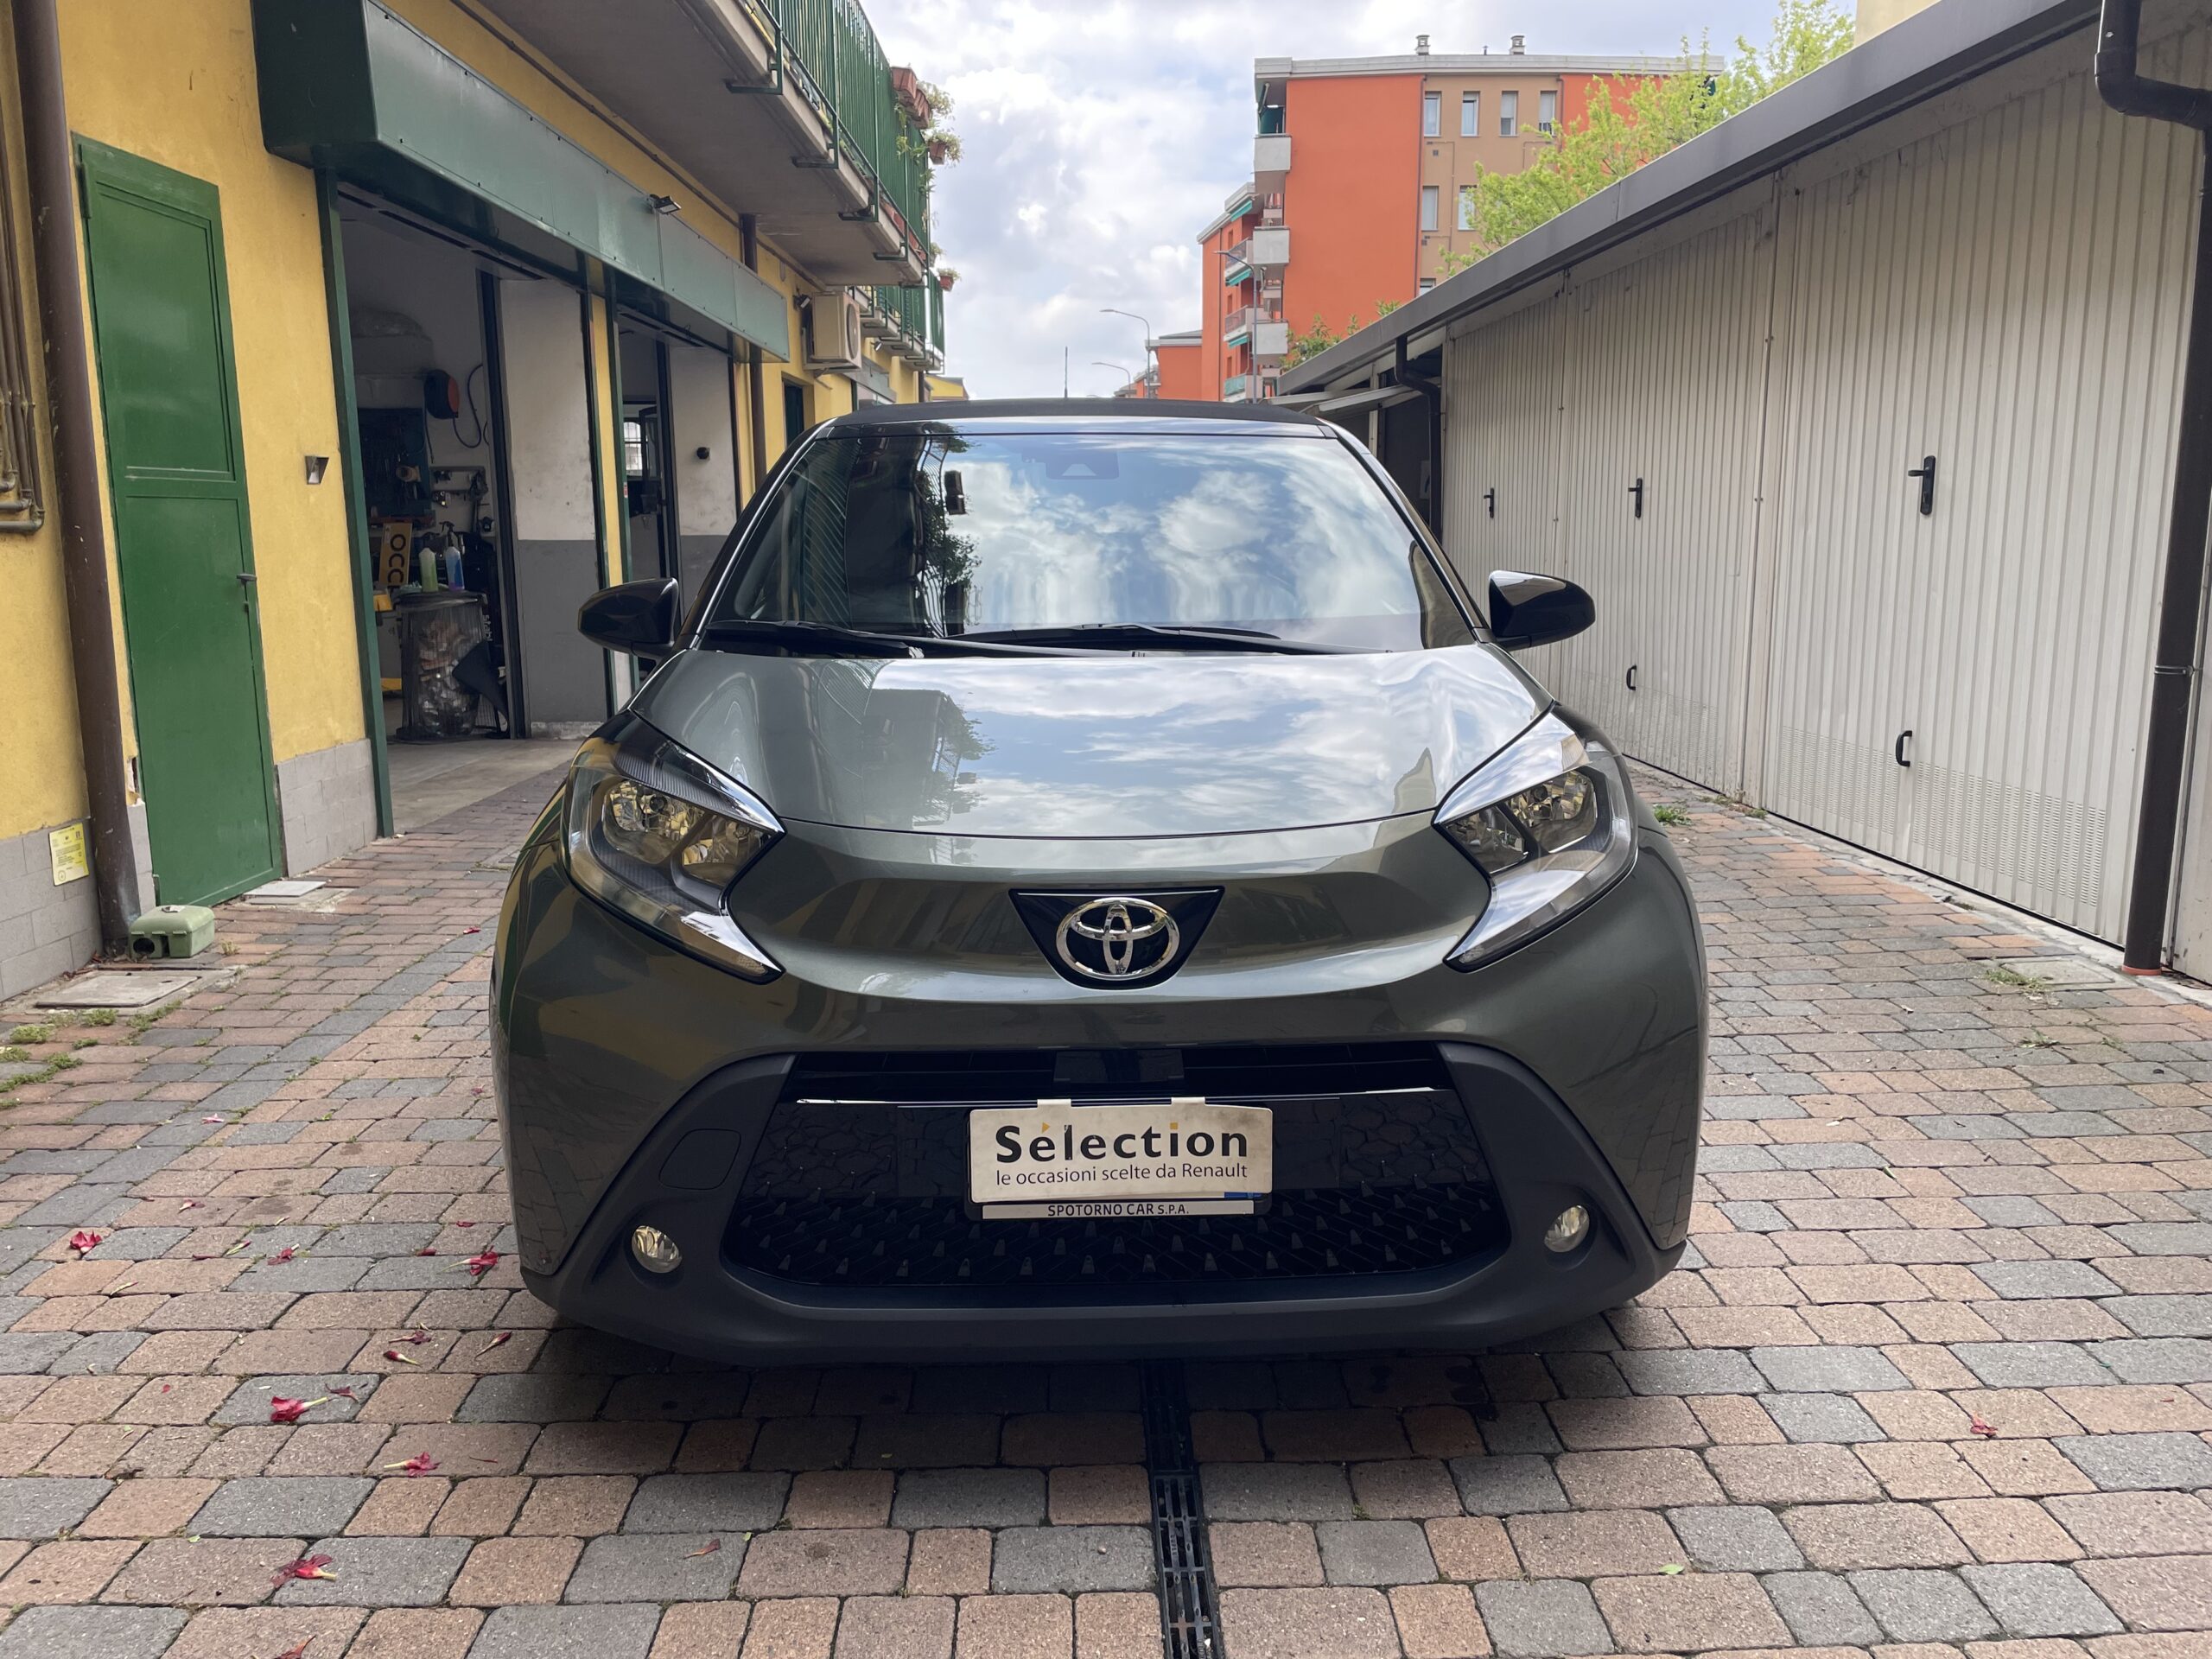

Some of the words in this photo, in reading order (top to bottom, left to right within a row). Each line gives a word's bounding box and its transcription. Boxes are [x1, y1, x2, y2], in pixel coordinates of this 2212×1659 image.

[996, 1169, 1011, 1185] le
[1016, 1166, 1096, 1185] occasioni
[1102, 1164, 1151, 1181] scelte
[1155, 1163, 1176, 1179] da
[1182, 1162, 1248, 1178] Renault
[1047, 1204, 1122, 1217] SPOTORNO
[1127, 1203, 1154, 1215] CAR
[1157, 1204, 1189, 1215] S.P.A.
